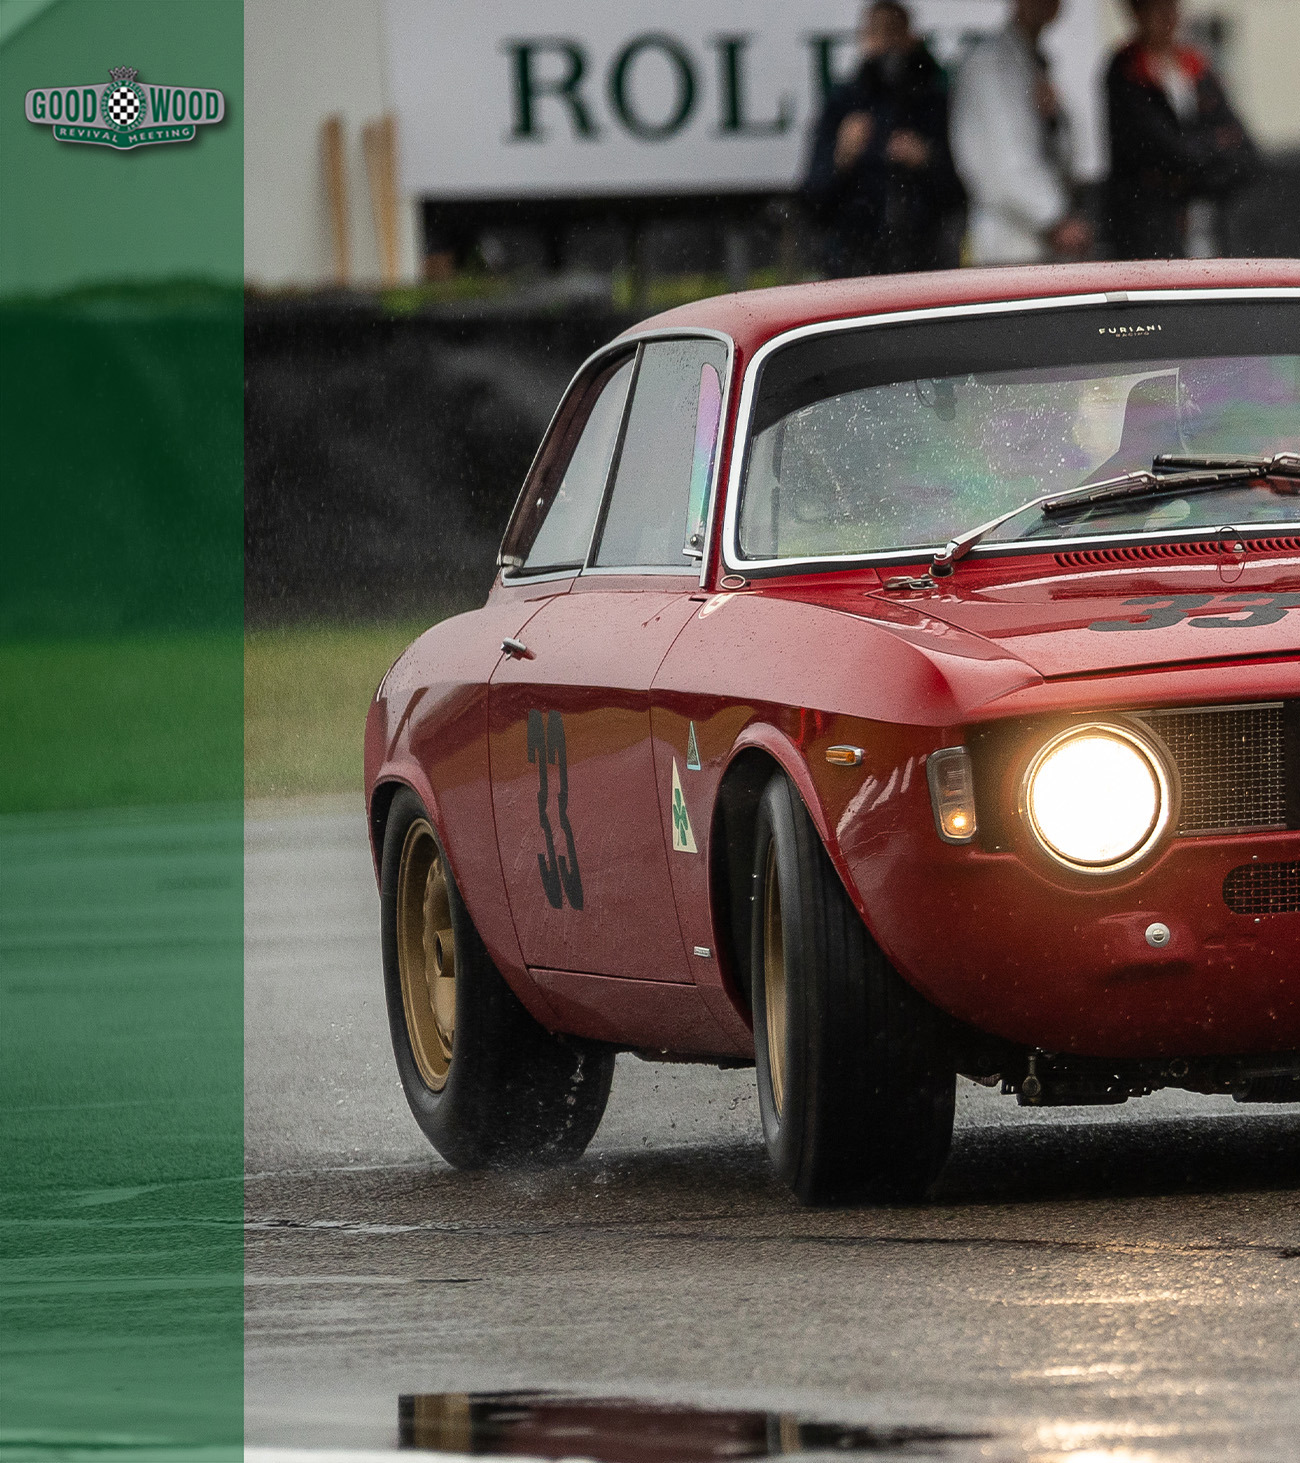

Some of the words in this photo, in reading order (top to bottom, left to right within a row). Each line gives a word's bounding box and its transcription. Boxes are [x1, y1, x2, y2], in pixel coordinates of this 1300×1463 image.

[502, 30, 994, 144] ROL
[1098, 324, 1162, 335] FURIANI
[526, 708, 585, 911] 33
